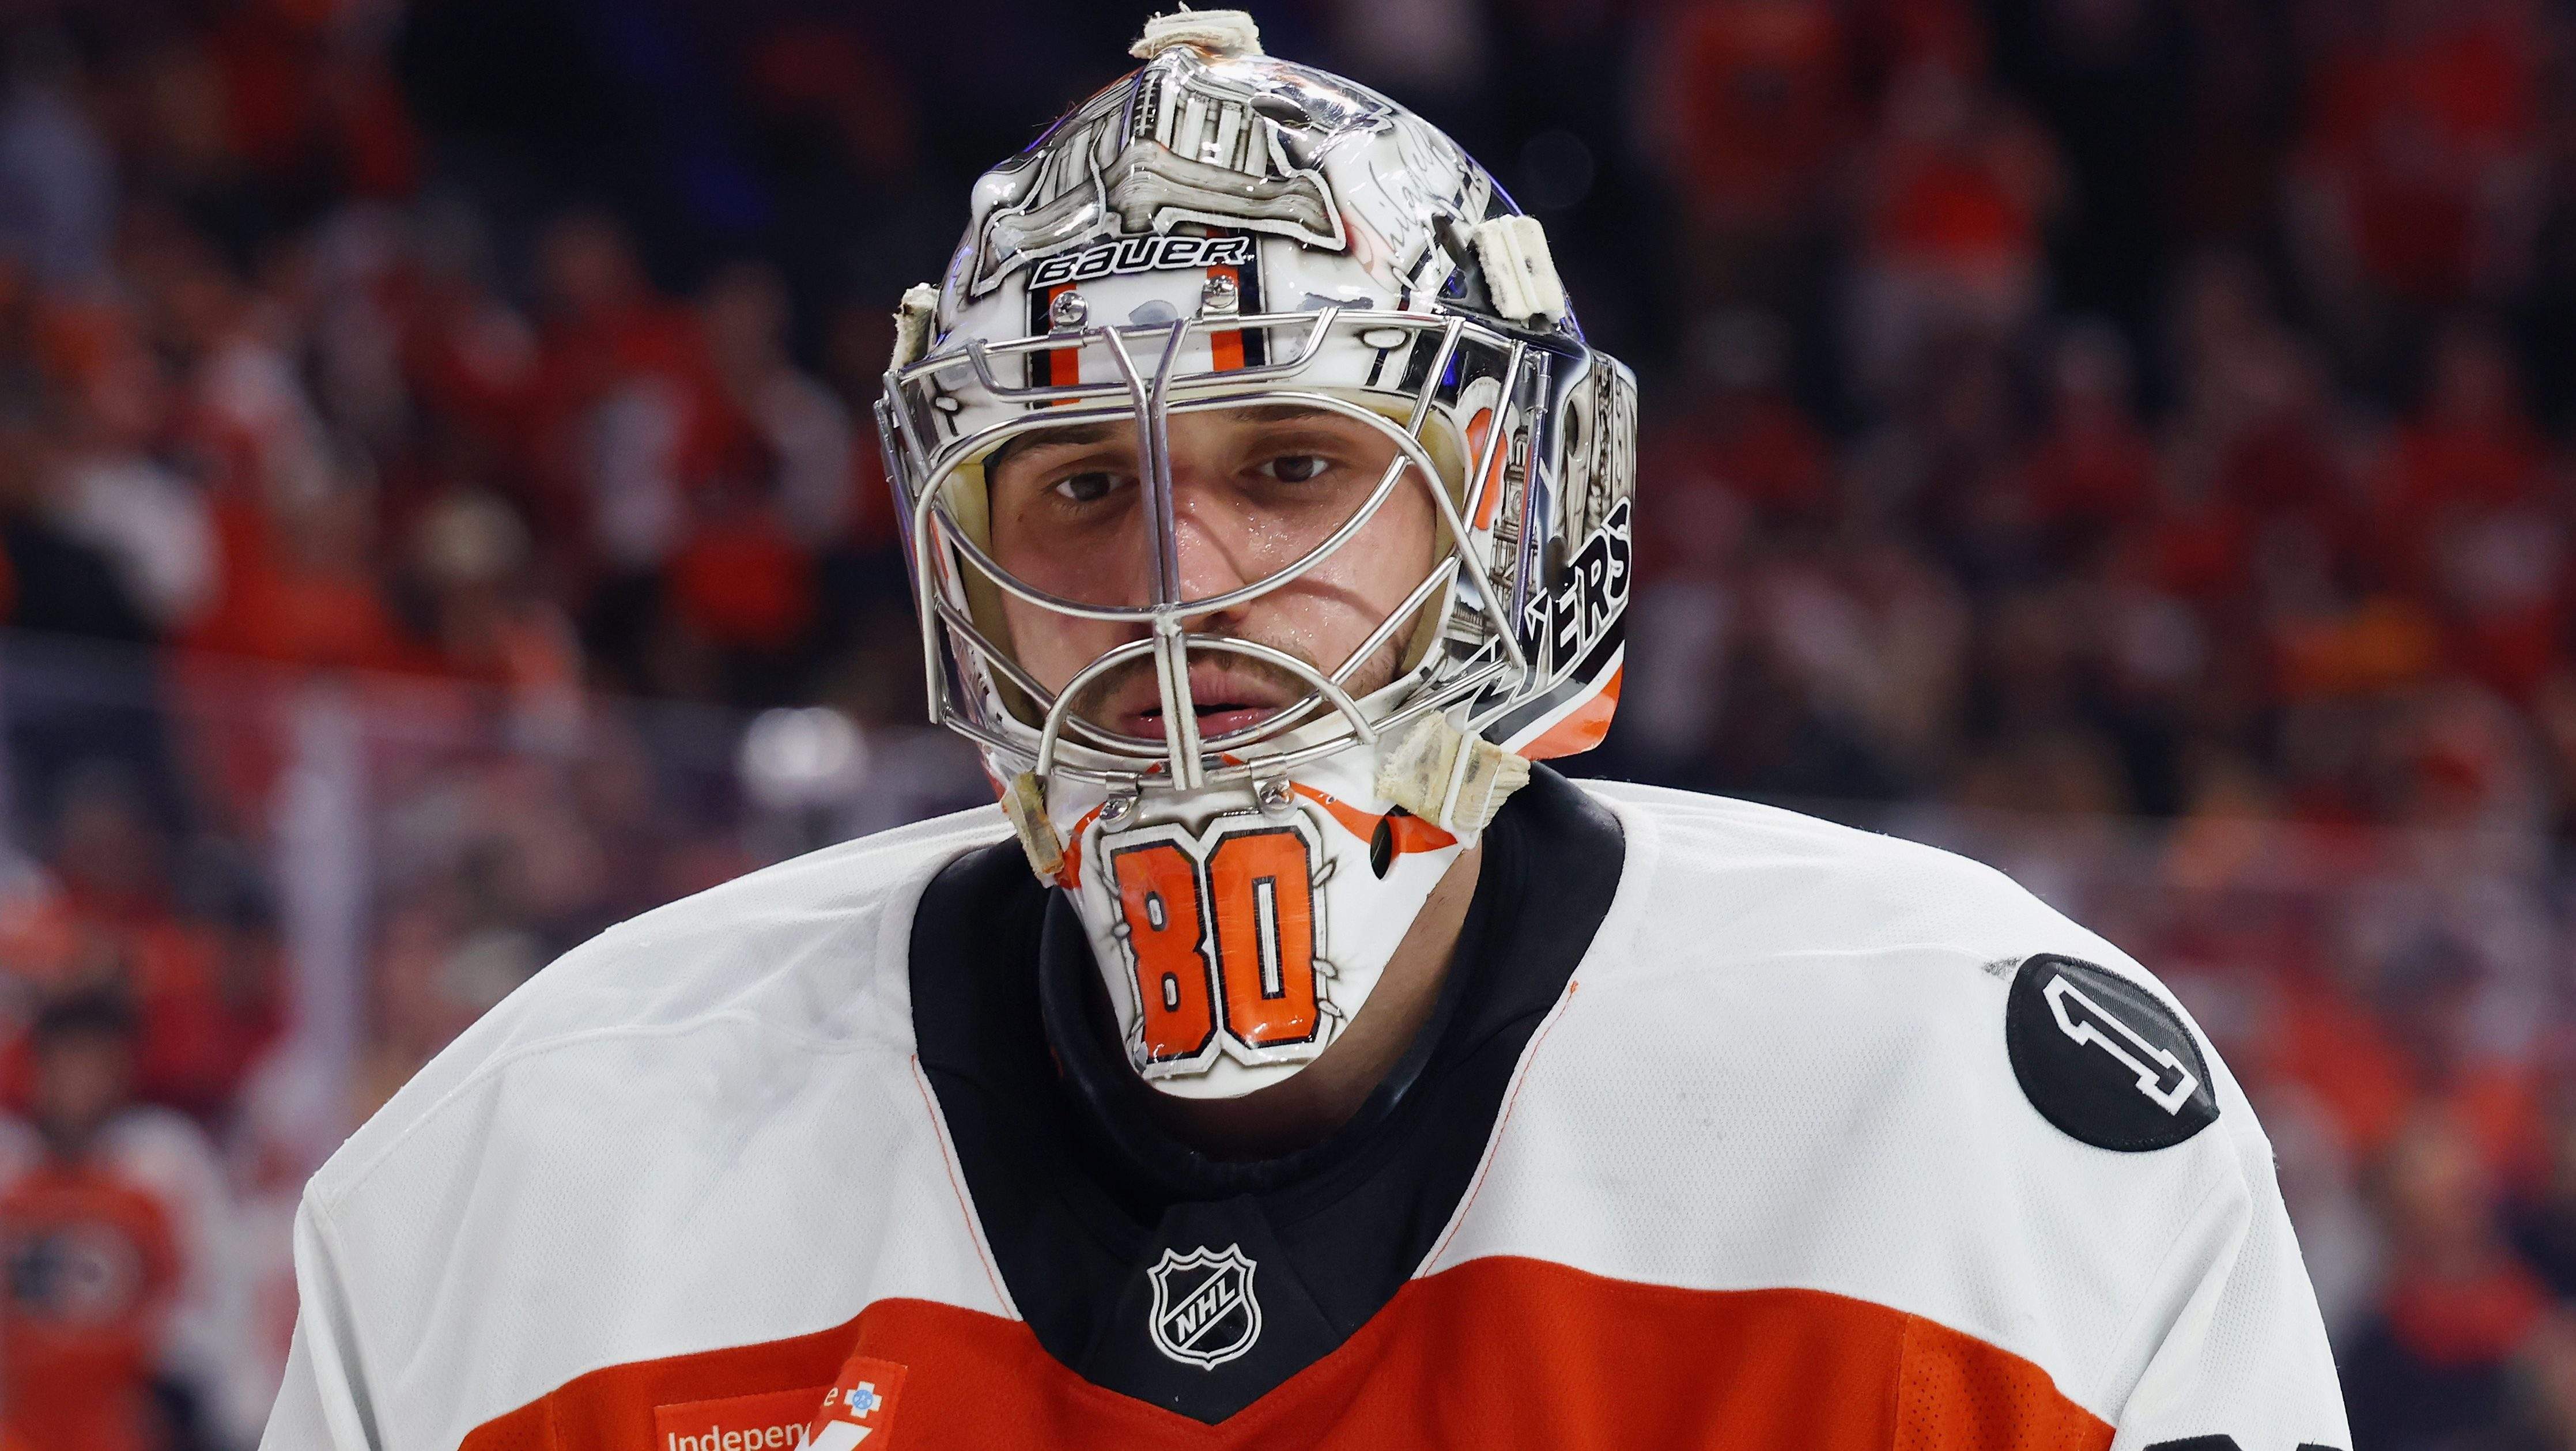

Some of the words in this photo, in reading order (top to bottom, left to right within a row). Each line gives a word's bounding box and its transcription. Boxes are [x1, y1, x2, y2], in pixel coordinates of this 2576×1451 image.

[1029, 235, 1250, 289] BAUER
[1106, 821, 1325, 1066] 80
[2042, 973, 2199, 1116] 1
[1175, 1277, 1236, 1343] NHL
